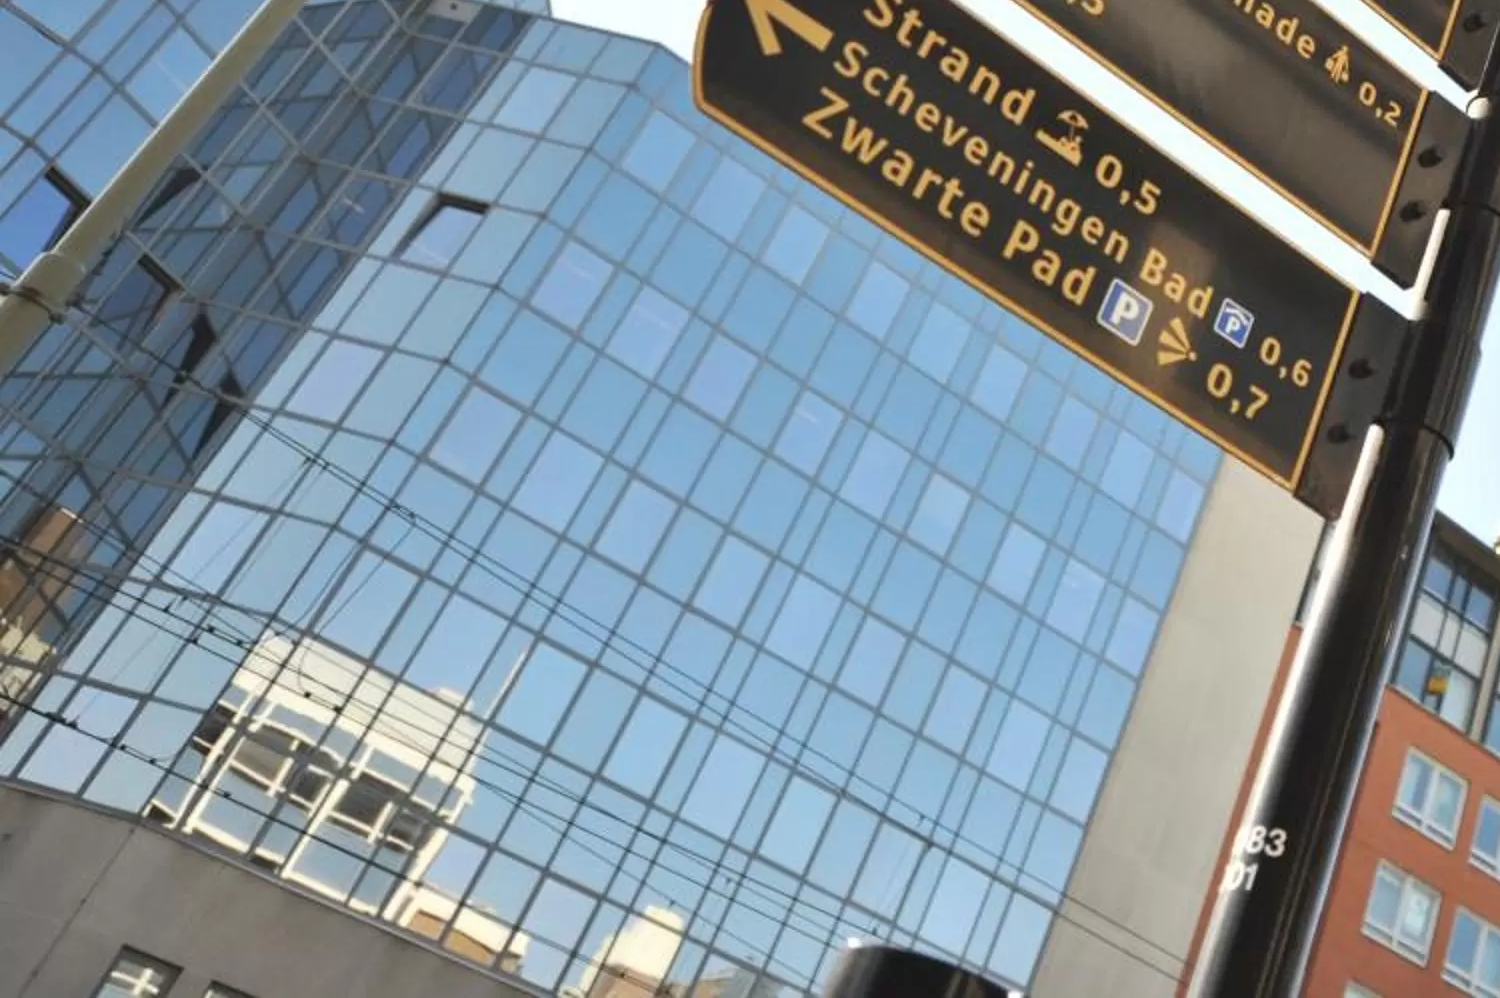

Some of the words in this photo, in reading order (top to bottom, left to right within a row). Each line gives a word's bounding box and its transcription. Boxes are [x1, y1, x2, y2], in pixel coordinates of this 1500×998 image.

[1094, 155, 1162, 216] 0,5
[1359, 82, 1402, 128] 0,2
[803, 87, 991, 238] Zwarte
[1003, 219, 1096, 306] Pad
[1206, 363, 1269, 421] 0,7
[833, 41, 1131, 265] Scheveningen
[1140, 248, 1213, 320] Bad
[1259, 337, 1313, 387] 0,6
